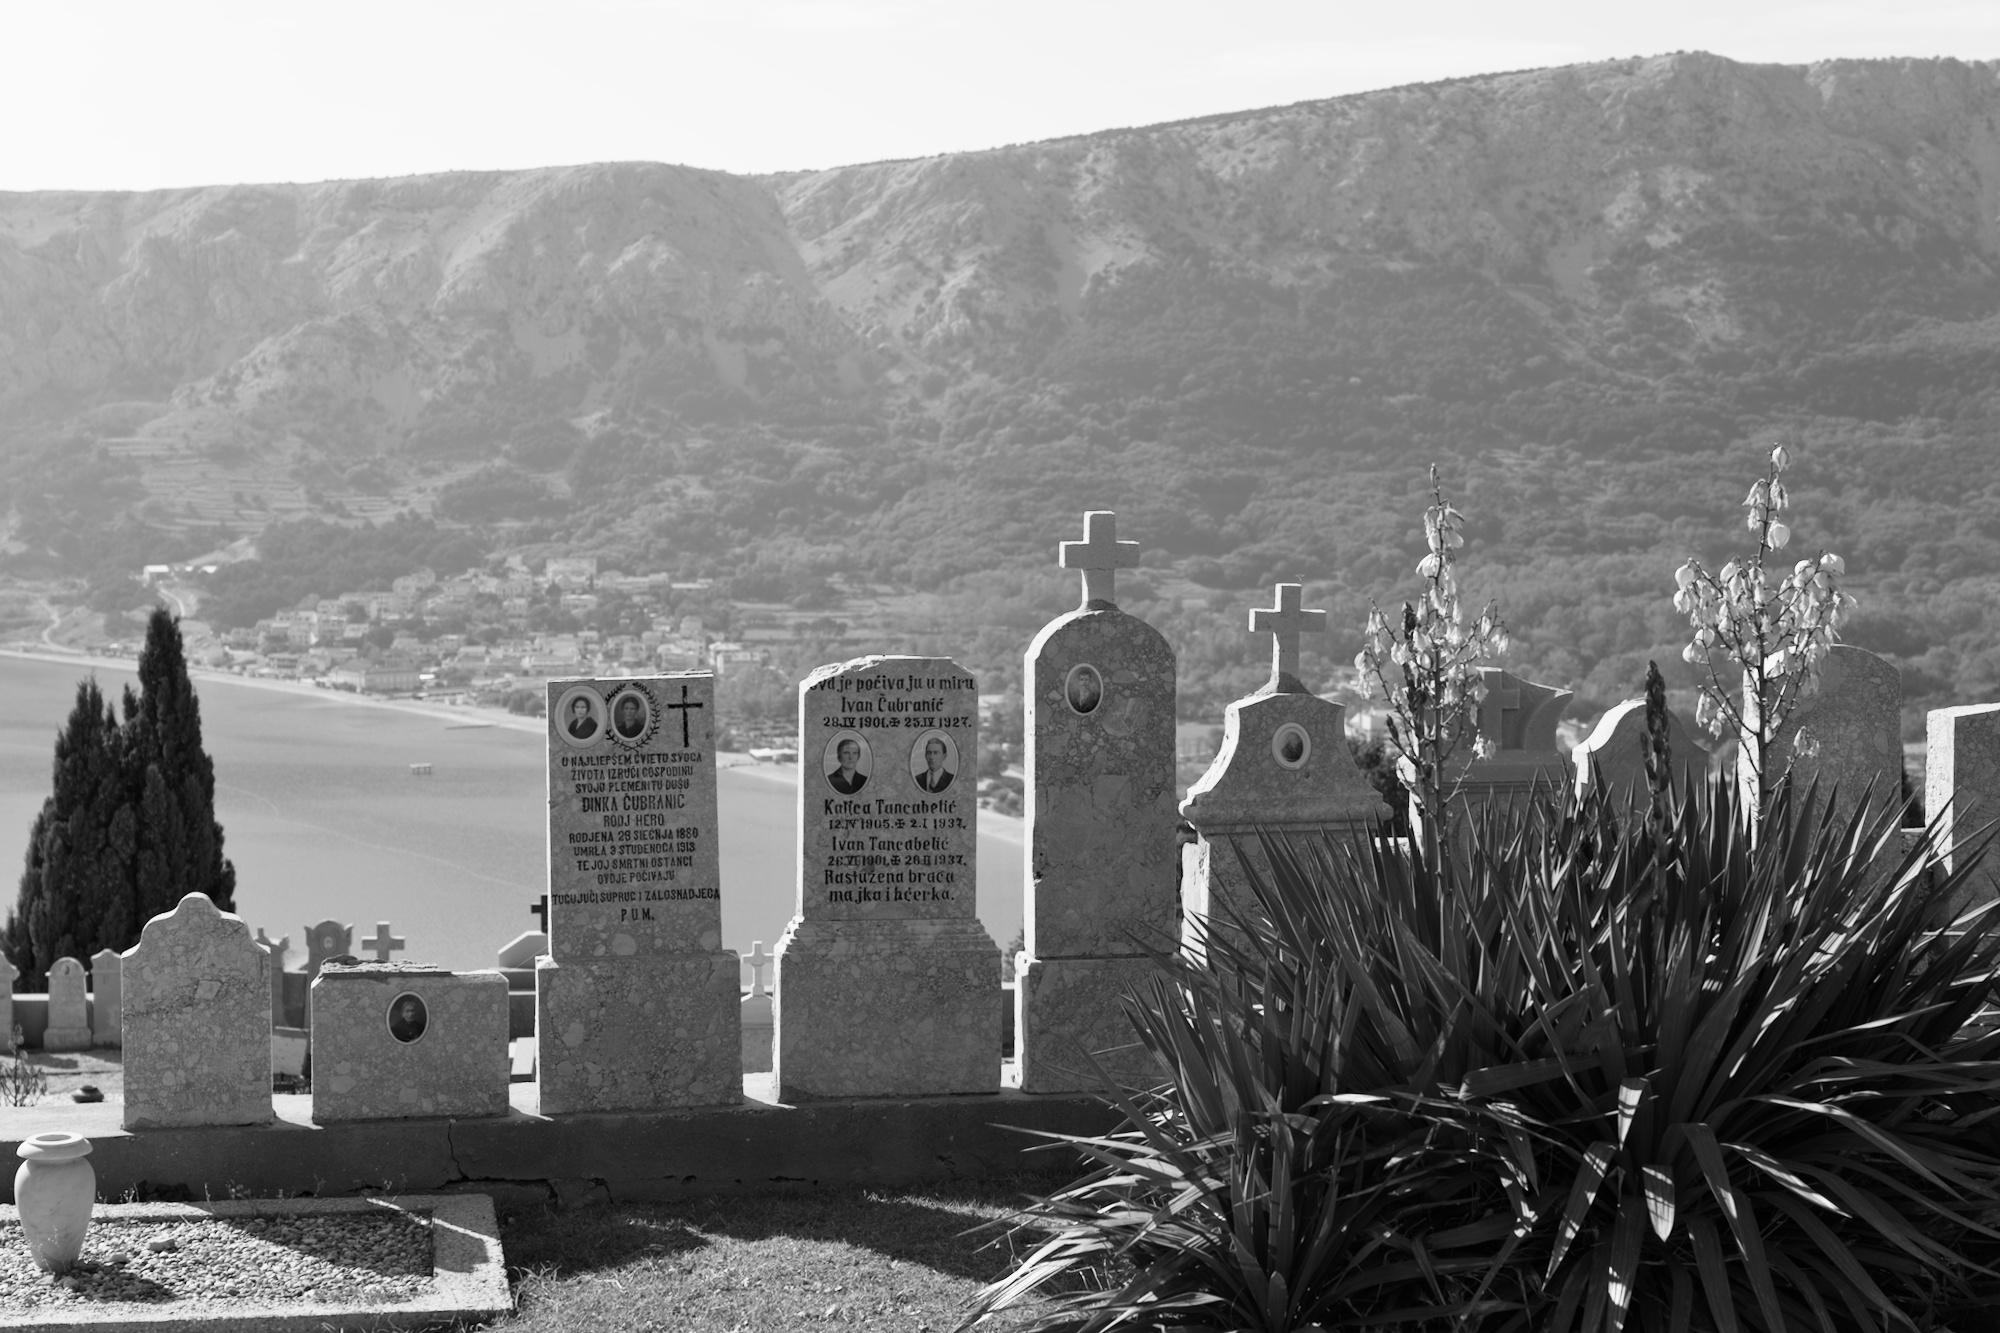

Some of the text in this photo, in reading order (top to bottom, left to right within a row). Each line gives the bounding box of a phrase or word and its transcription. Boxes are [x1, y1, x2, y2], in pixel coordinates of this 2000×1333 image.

[927, 679, 936, 690] u
[940, 676, 974, 690] miru
[841, 694, 943, 712] Ivan Čubranić
[562, 757, 568, 766] U
[576, 782, 605, 794] SVOJU
[608, 780, 662, 792] PLEMENITU
[582, 796, 618, 812] DINKA
[604, 814, 665, 827] RODJ HERO
[569, 831, 614, 844] RODJENA
[618, 830, 631, 842] 28
[832, 836, 864, 851] Ivan
[610, 846, 616, 855] 3
[577, 856, 693, 871] TE JOJ SMRTNI OSTANCI
[598, 872, 627, 884] OVDJE
[829, 886, 881, 904] majka
[886, 887, 890, 901] i
